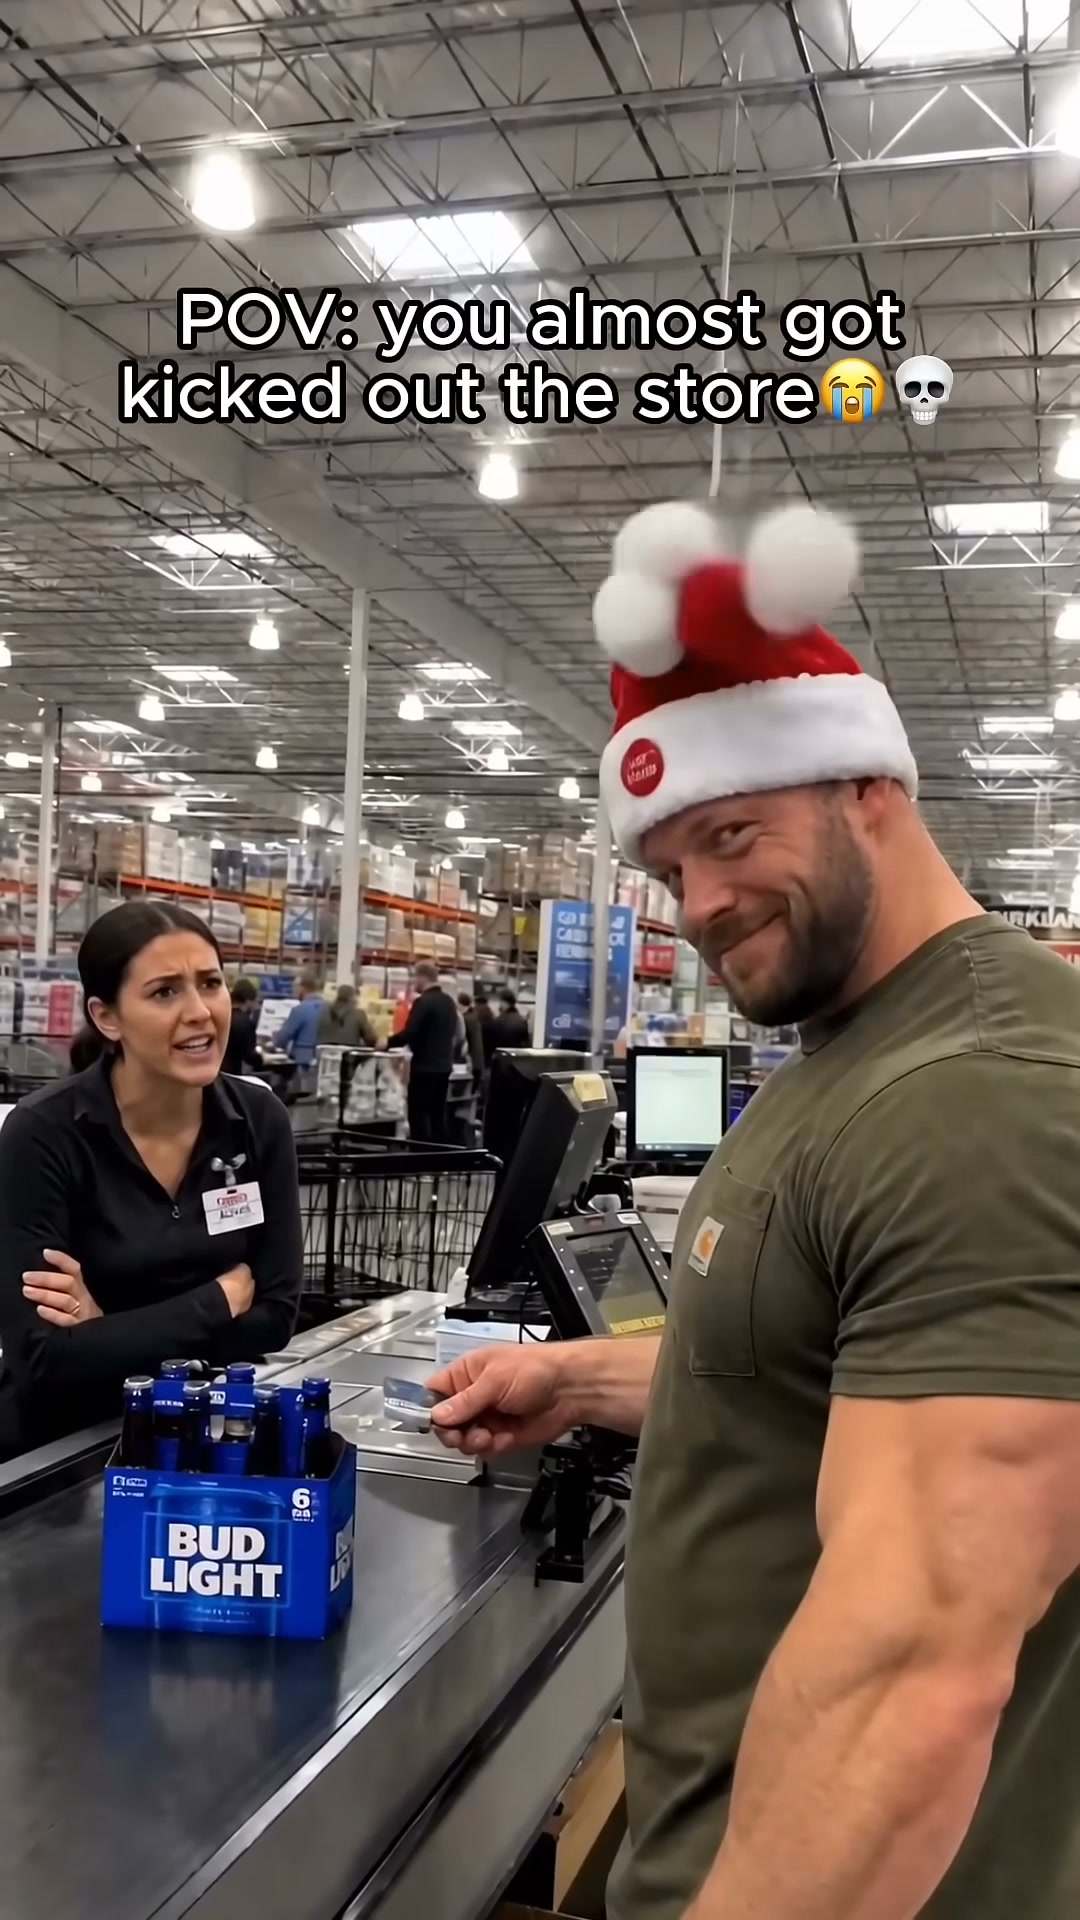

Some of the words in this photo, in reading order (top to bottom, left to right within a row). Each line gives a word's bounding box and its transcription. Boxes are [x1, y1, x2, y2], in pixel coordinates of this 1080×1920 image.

[292, 1487, 311, 1509] 6
[168, 1523, 266, 1561] BUD
[150, 1558, 283, 1598] LIGHT
